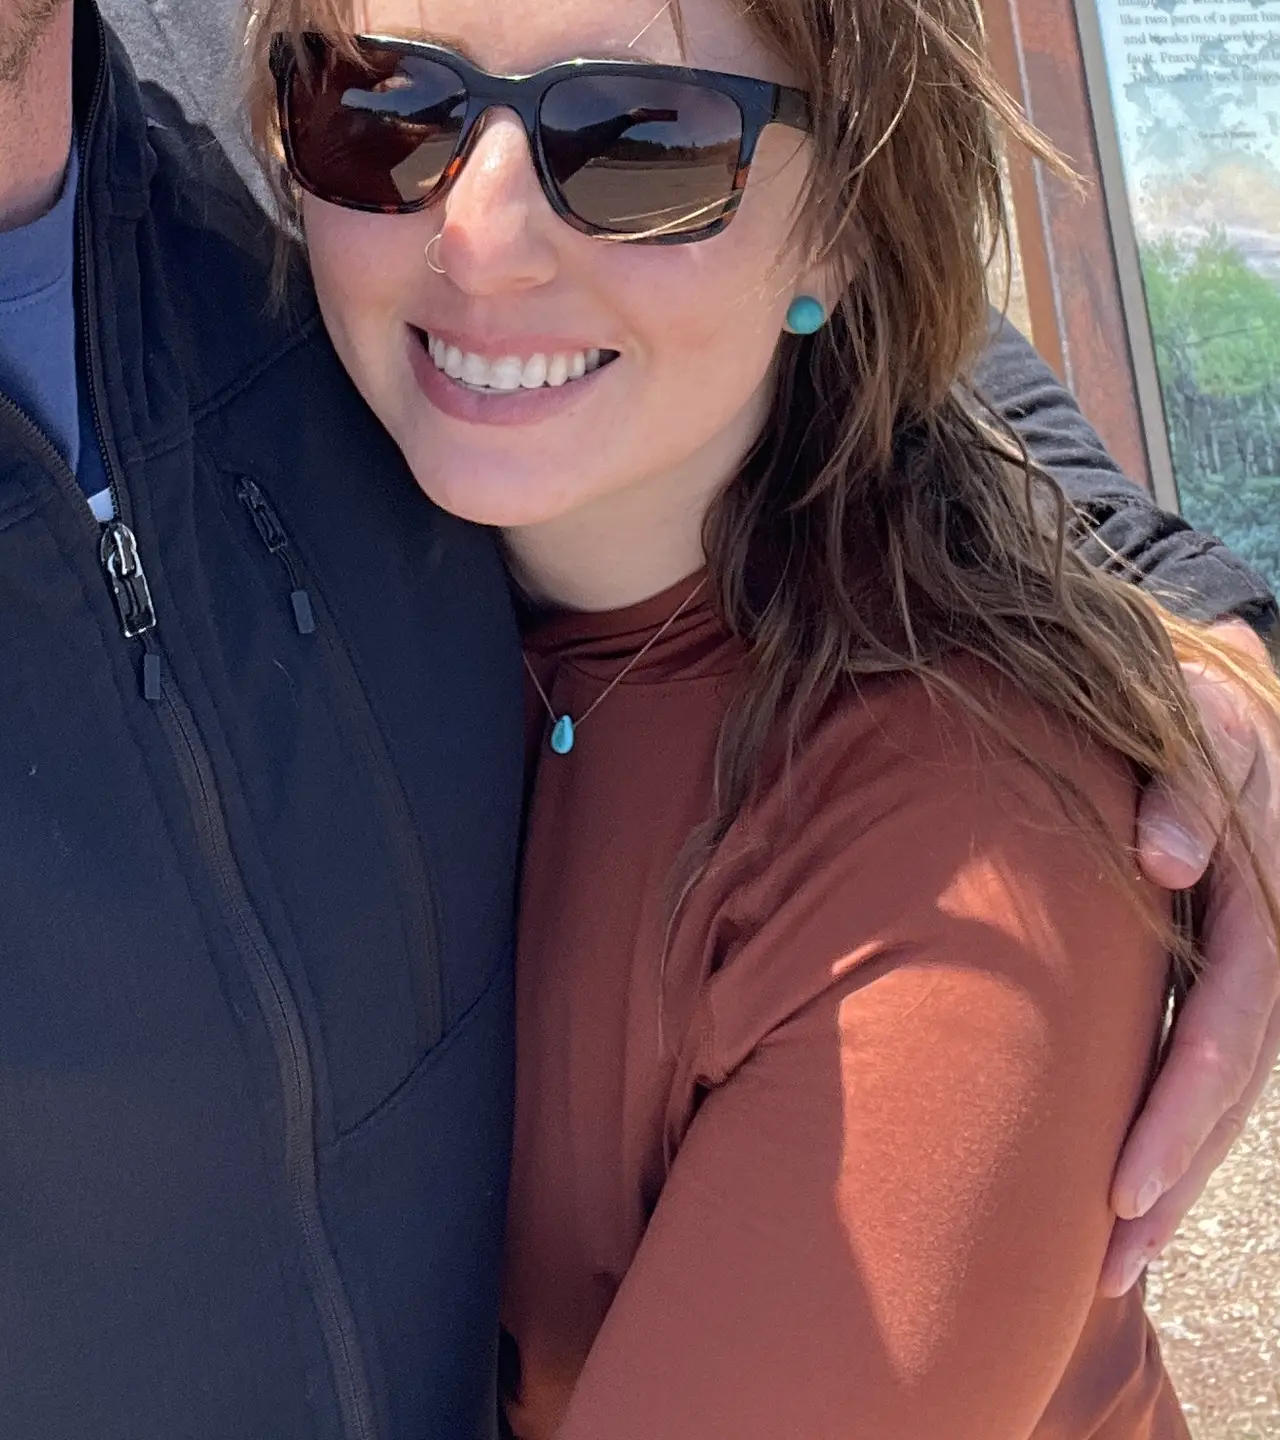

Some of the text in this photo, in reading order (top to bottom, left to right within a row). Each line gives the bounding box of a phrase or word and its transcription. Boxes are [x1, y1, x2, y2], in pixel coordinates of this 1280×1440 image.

[1120, 14, 1141, 24] like
[1145, 13, 1167, 24] two
[1171, 13, 1200, 26] parts
[1230, 12, 1259, 25] giant
[1124, 33, 1145, 44] and
